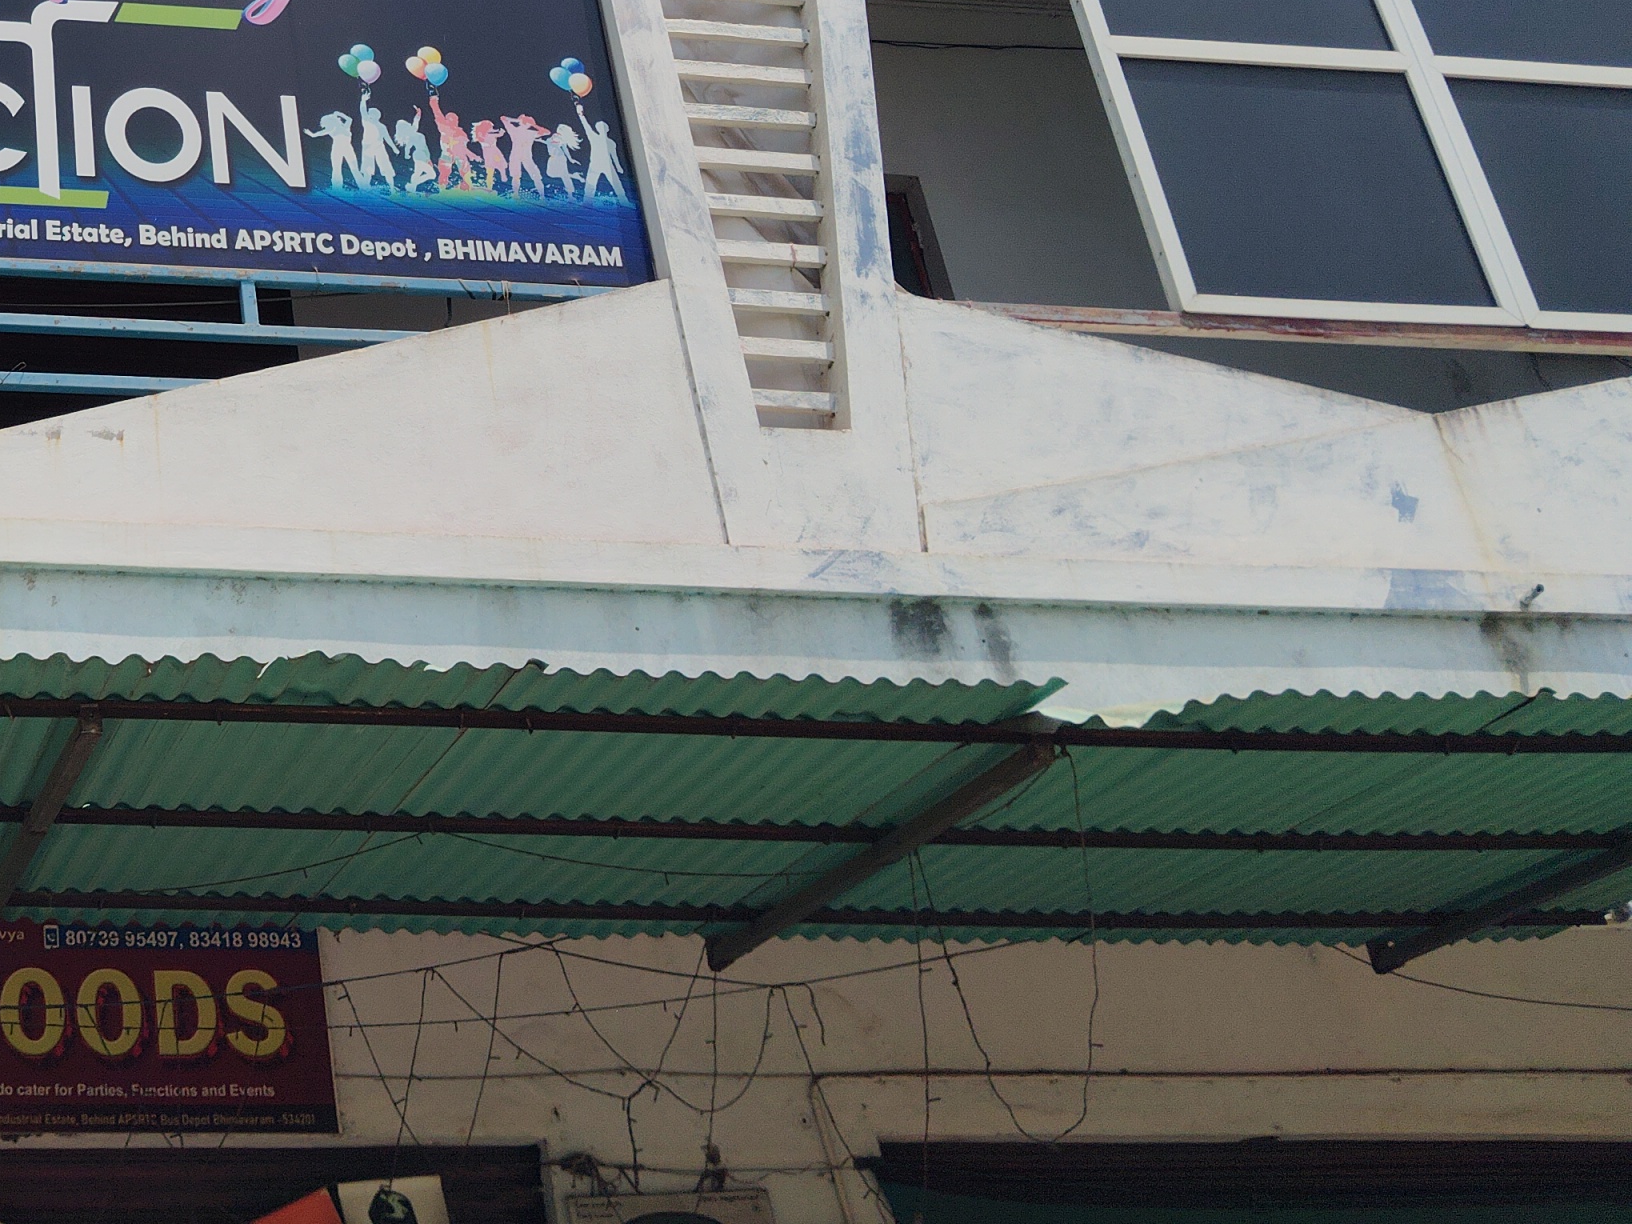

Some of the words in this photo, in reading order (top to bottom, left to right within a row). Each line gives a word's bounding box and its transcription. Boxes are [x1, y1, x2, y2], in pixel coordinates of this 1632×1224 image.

[45, 219, 133, 248] Estate,
[139, 223, 228, 251] Behind
[234, 228, 334, 257] APSRTC
[340, 234, 417, 261] Depot
[438, 238, 623, 268] BHIMAVARAM
[189, 930, 244, 948] 83418
[248, 930, 302, 949] 98943
[17, 1084, 51, 1097] cater
[54, 1083, 74, 1097] for
[77, 1083, 129, 1099] Parties,
[201, 1084, 227, 1098] and
[230, 1084, 276, 1098] Events
